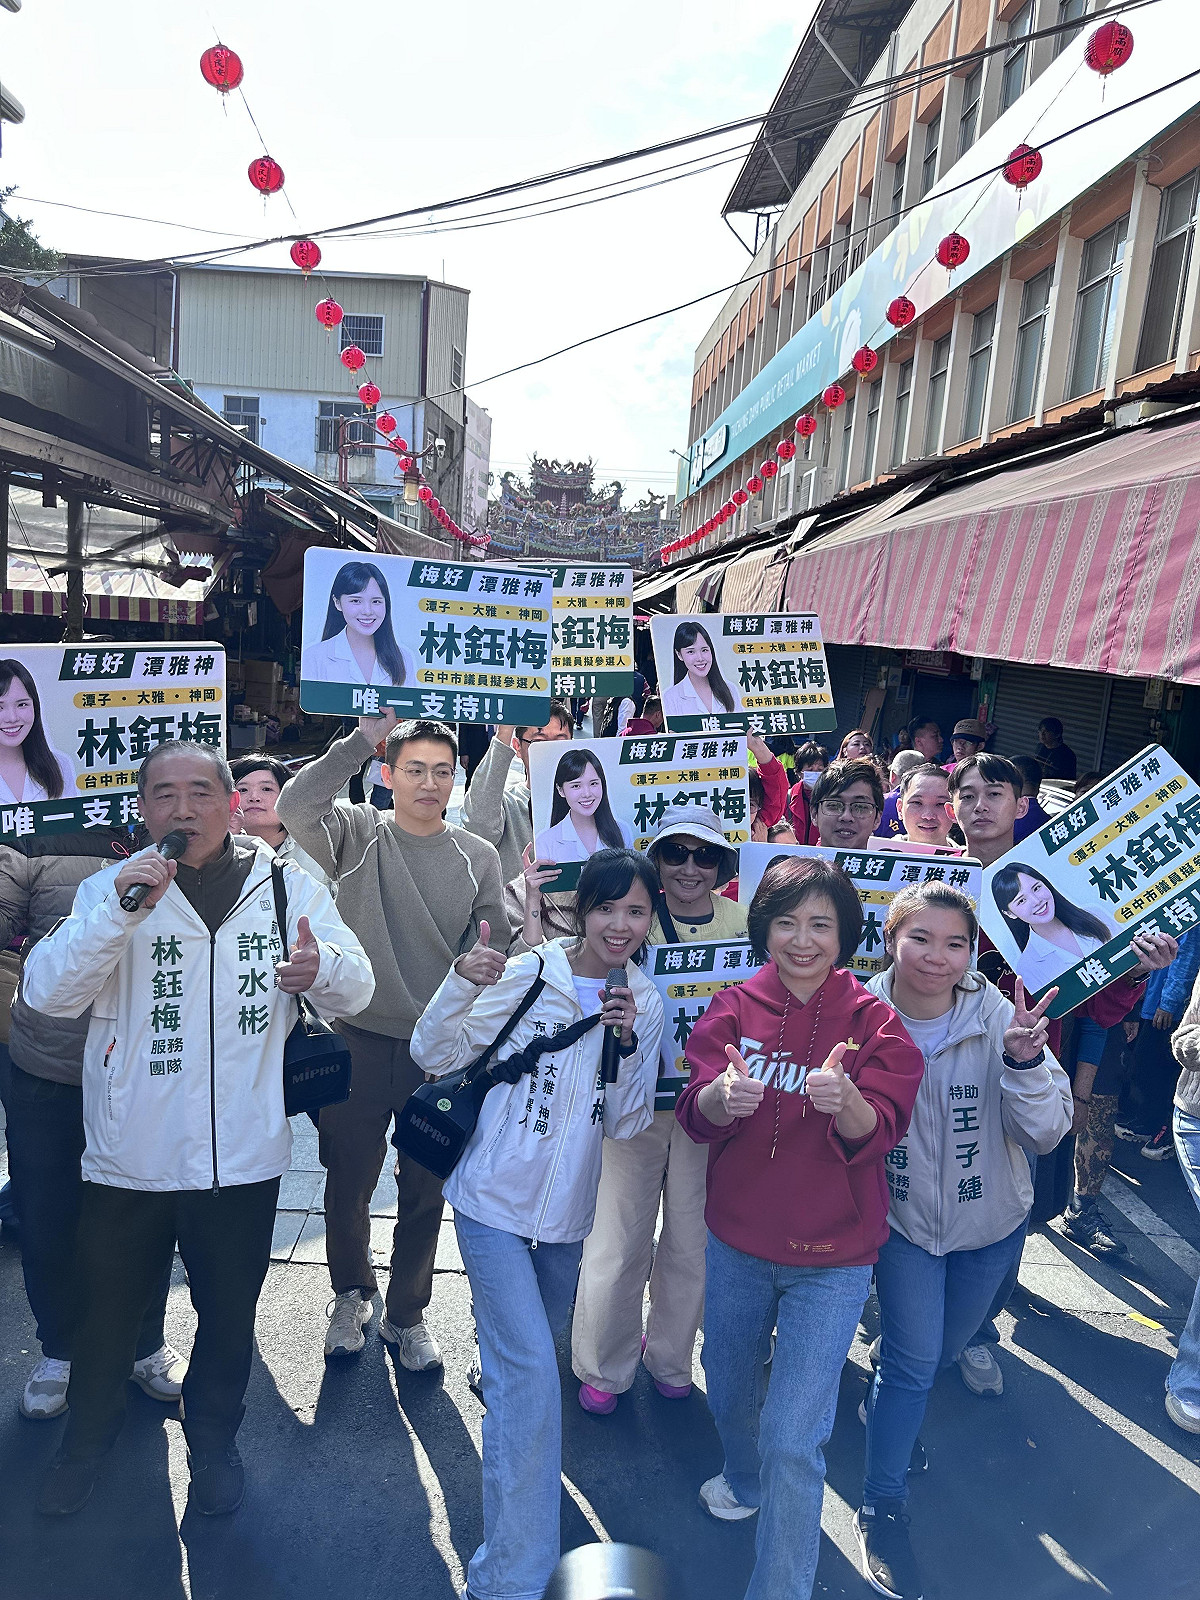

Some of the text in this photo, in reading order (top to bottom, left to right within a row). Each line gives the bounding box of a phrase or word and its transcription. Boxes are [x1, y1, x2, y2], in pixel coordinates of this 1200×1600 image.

[795, 341, 822, 383] MARKET
[419, 565, 543, 598] 梅好 潭雅神
[570, 571, 625, 588] 潭雅神
[729, 618, 813, 634] 梅好 潭雅神
[418, 621, 548, 670] 林鈺梅
[73, 652, 215, 676] 梅好 潭雅神
[738, 657, 827, 692] 林鈺梅
[423, 671, 541, 691] 台中市議員擬參選人
[352, 687, 504, 721] 唯一支持!!
[746, 694, 827, 707] 台中市議員擬參選人
[700, 712, 806, 733] 唯一支持!!
[629, 740, 739, 761] 梅好 潭雅神
[1049, 757, 1161, 845] 梅好 潭雅神
[842, 856, 970, 887] 梅好 潭雅神
[664, 949, 706, 970] 梅好
[150, 935, 184, 1033] 林鈺梅
[237, 932, 270, 1035] 許水彬
[151, 1038, 184, 1054] 服務
[149, 1058, 183, 1076] 團隊
[740, 1036, 850, 1096] Taiw
[949, 1084, 979, 1100] 特助
